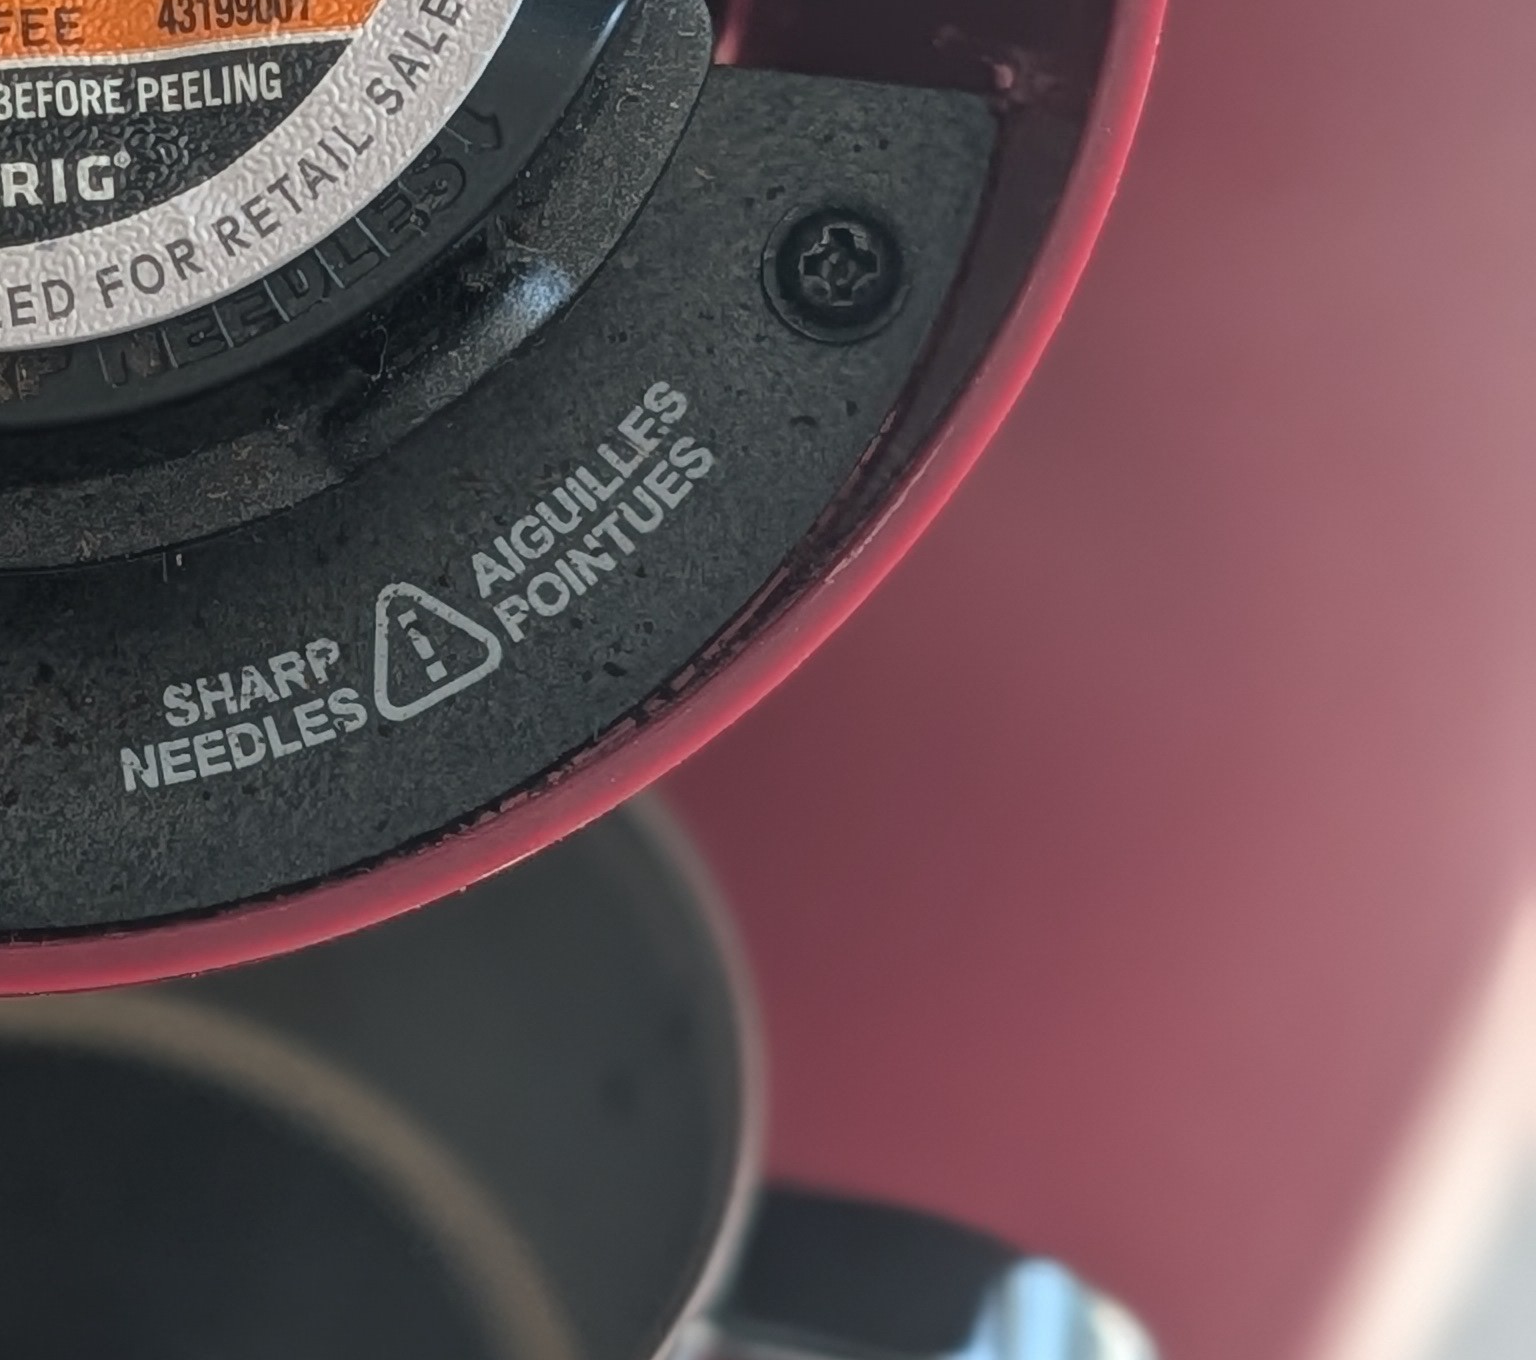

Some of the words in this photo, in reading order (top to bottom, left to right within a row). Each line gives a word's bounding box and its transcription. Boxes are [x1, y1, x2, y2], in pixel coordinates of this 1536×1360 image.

[137, 61, 284, 114] PEELING
[96, 239, 203, 309] FOR
[211, 124, 375, 257] RETAIL
[470, 380, 689, 598] AIGUILLES
[492, 435, 714, 642] POINTUES
[119, 687, 368, 792] NEEDLES
[163, 637, 341, 727] SHARP
